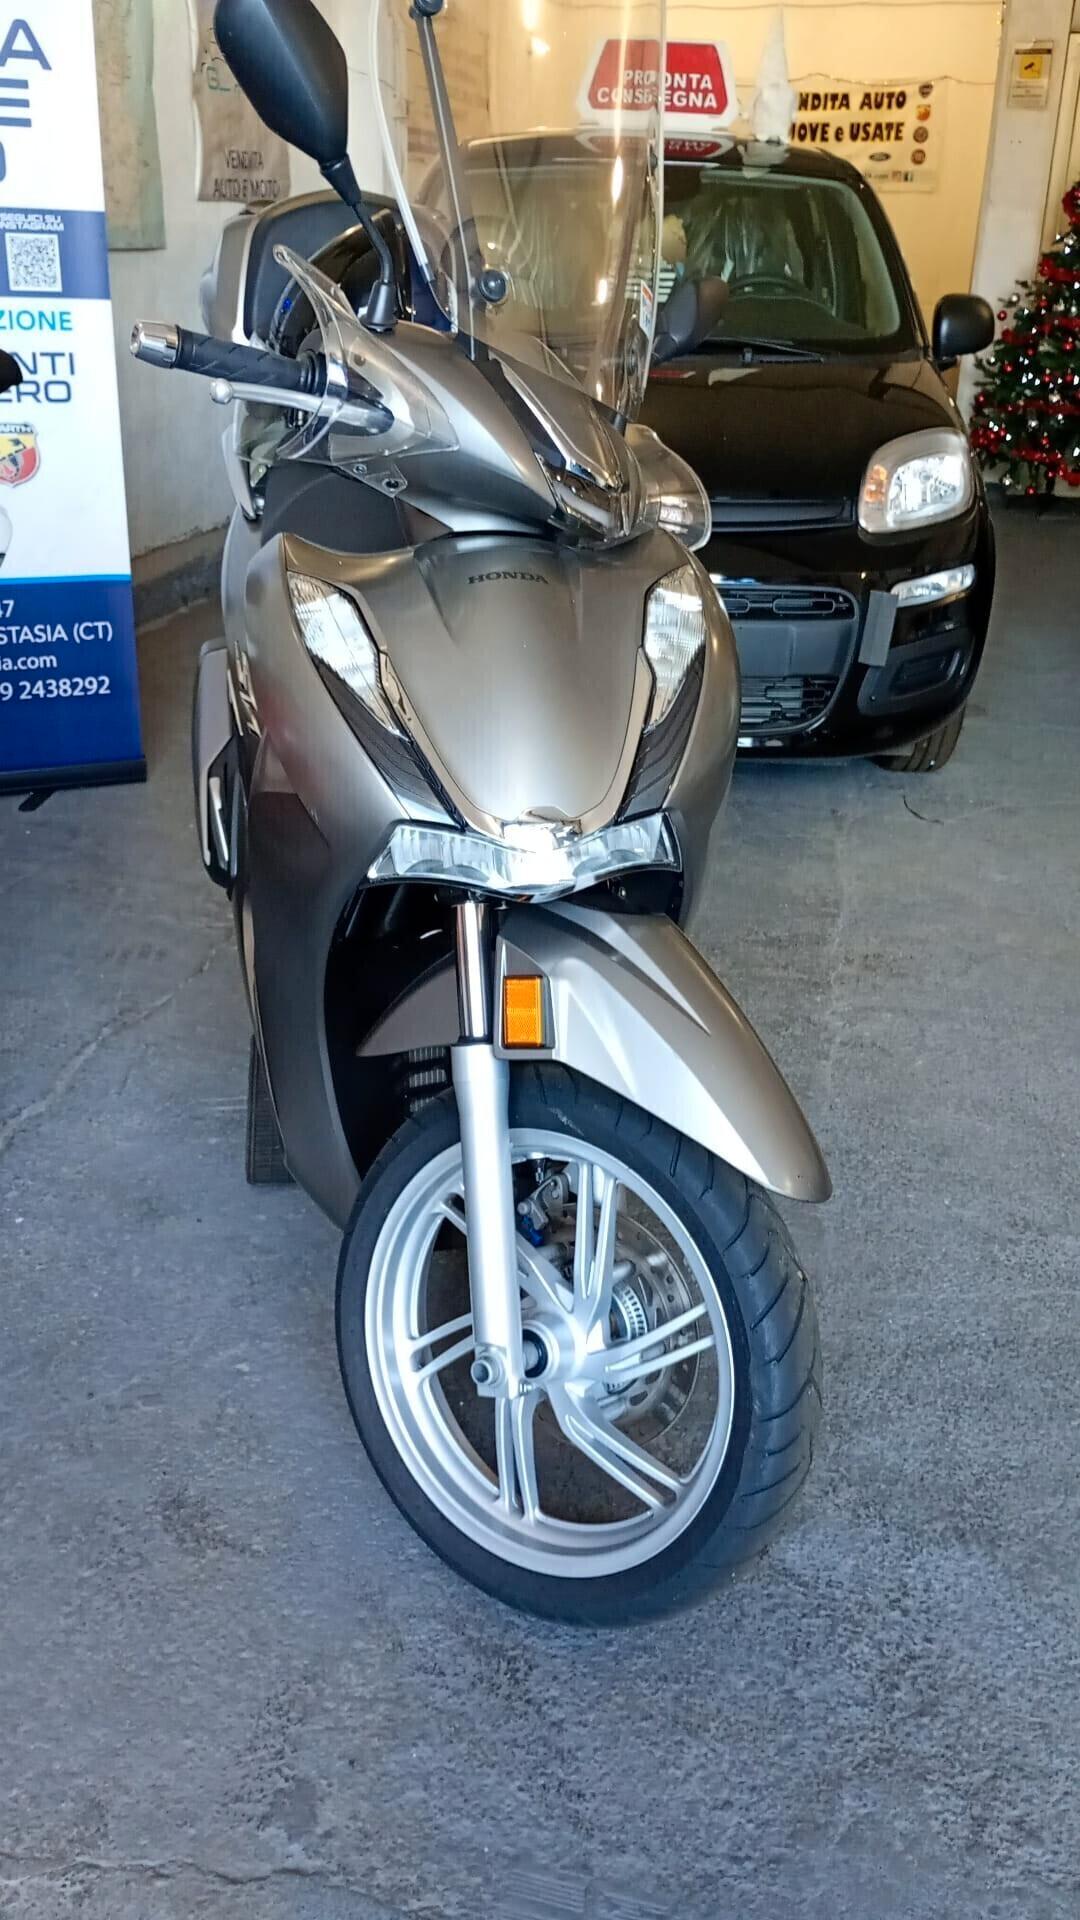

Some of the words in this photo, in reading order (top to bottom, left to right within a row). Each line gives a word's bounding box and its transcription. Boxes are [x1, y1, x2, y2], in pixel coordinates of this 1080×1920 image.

[859, 91, 906, 110] AUTO
[835, 126, 844, 142] e
[850, 122, 904, 143] USATE
[213, 178, 241, 198] AUTO
[250, 179, 281, 198] MOTO
[468, 571, 549, 584] HONDA
[73, 621, 113, 643] (CT)
[19, 675, 111, 700] 2438292
